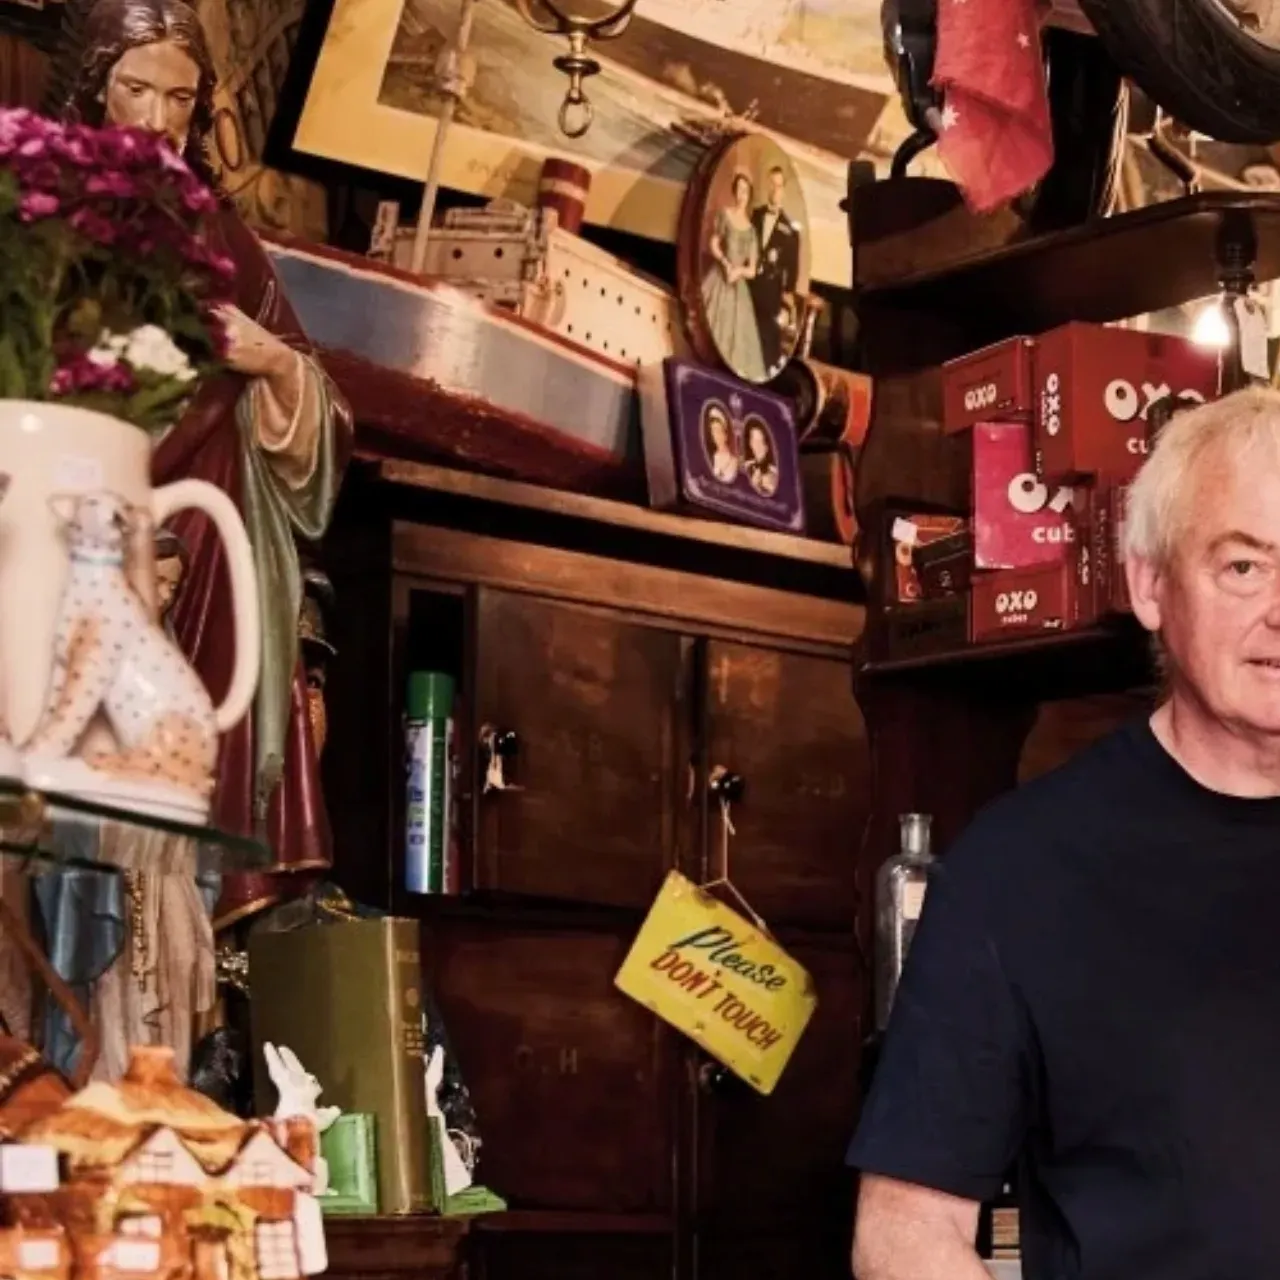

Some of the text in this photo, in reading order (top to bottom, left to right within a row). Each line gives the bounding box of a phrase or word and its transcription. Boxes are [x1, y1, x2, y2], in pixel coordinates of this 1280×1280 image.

[964, 383, 997, 411] OXO
[1104, 378, 1206, 421] OX
[995, 590, 1038, 614] OXO
[669, 925, 788, 991] Please
[650, 950, 783, 1051] DON'T TOUCH
